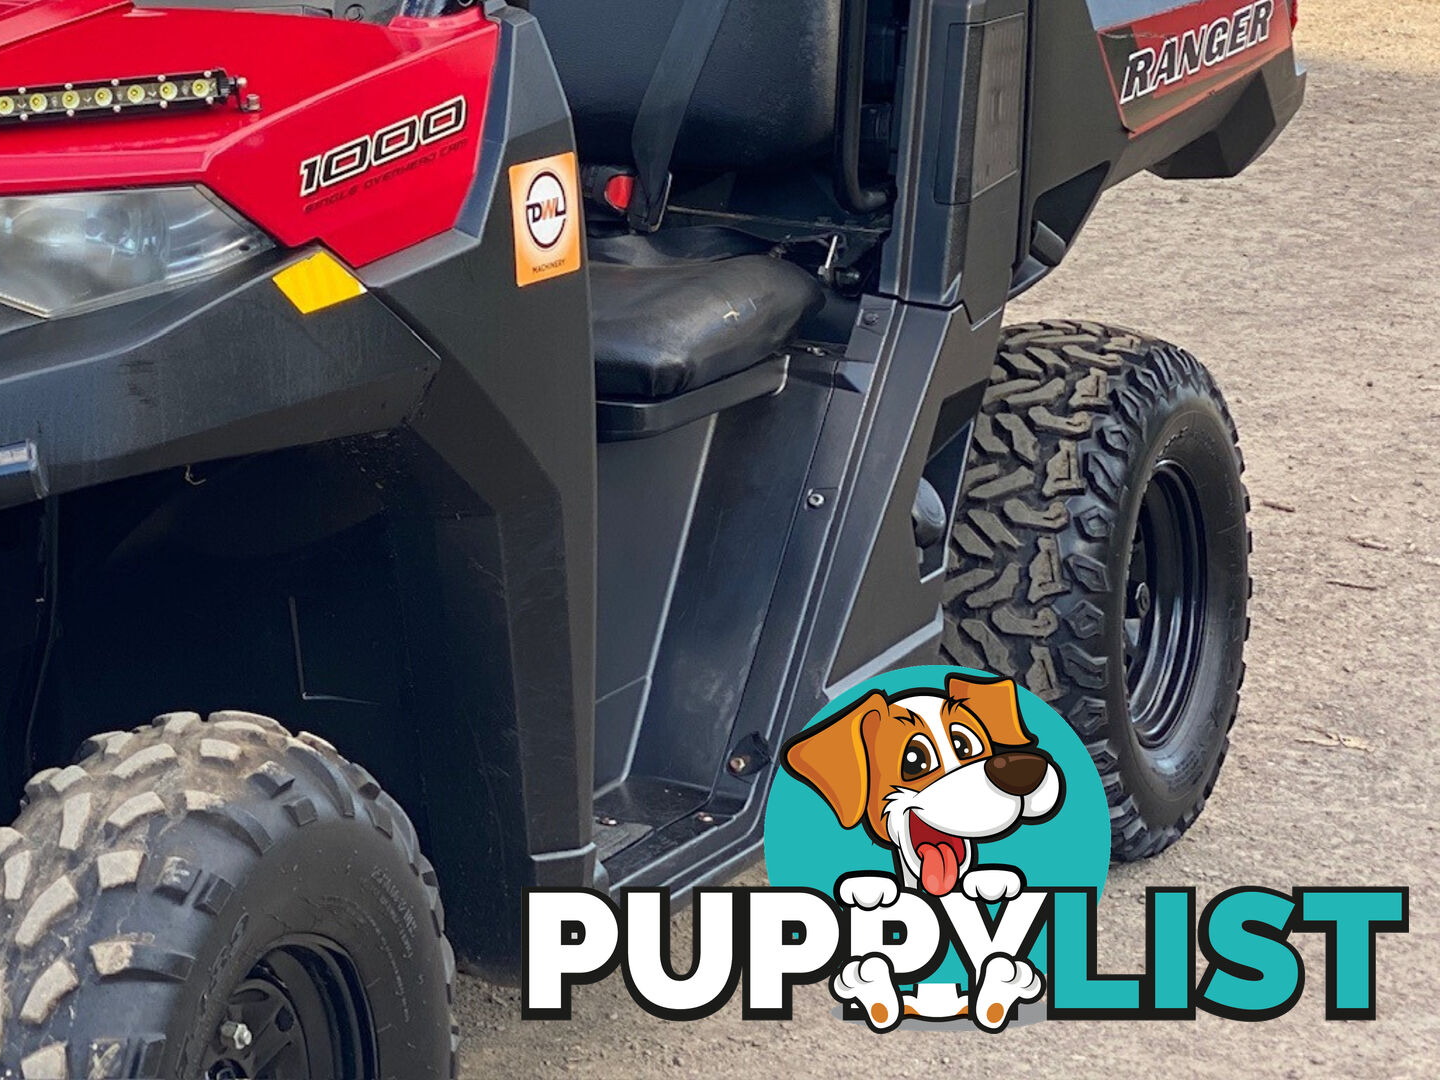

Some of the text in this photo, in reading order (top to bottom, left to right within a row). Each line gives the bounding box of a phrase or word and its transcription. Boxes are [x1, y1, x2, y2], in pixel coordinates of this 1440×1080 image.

[300, 95, 466, 197] 1000
[526, 197, 566, 223] DWL
[532, 259, 566, 274] MACHINERY
